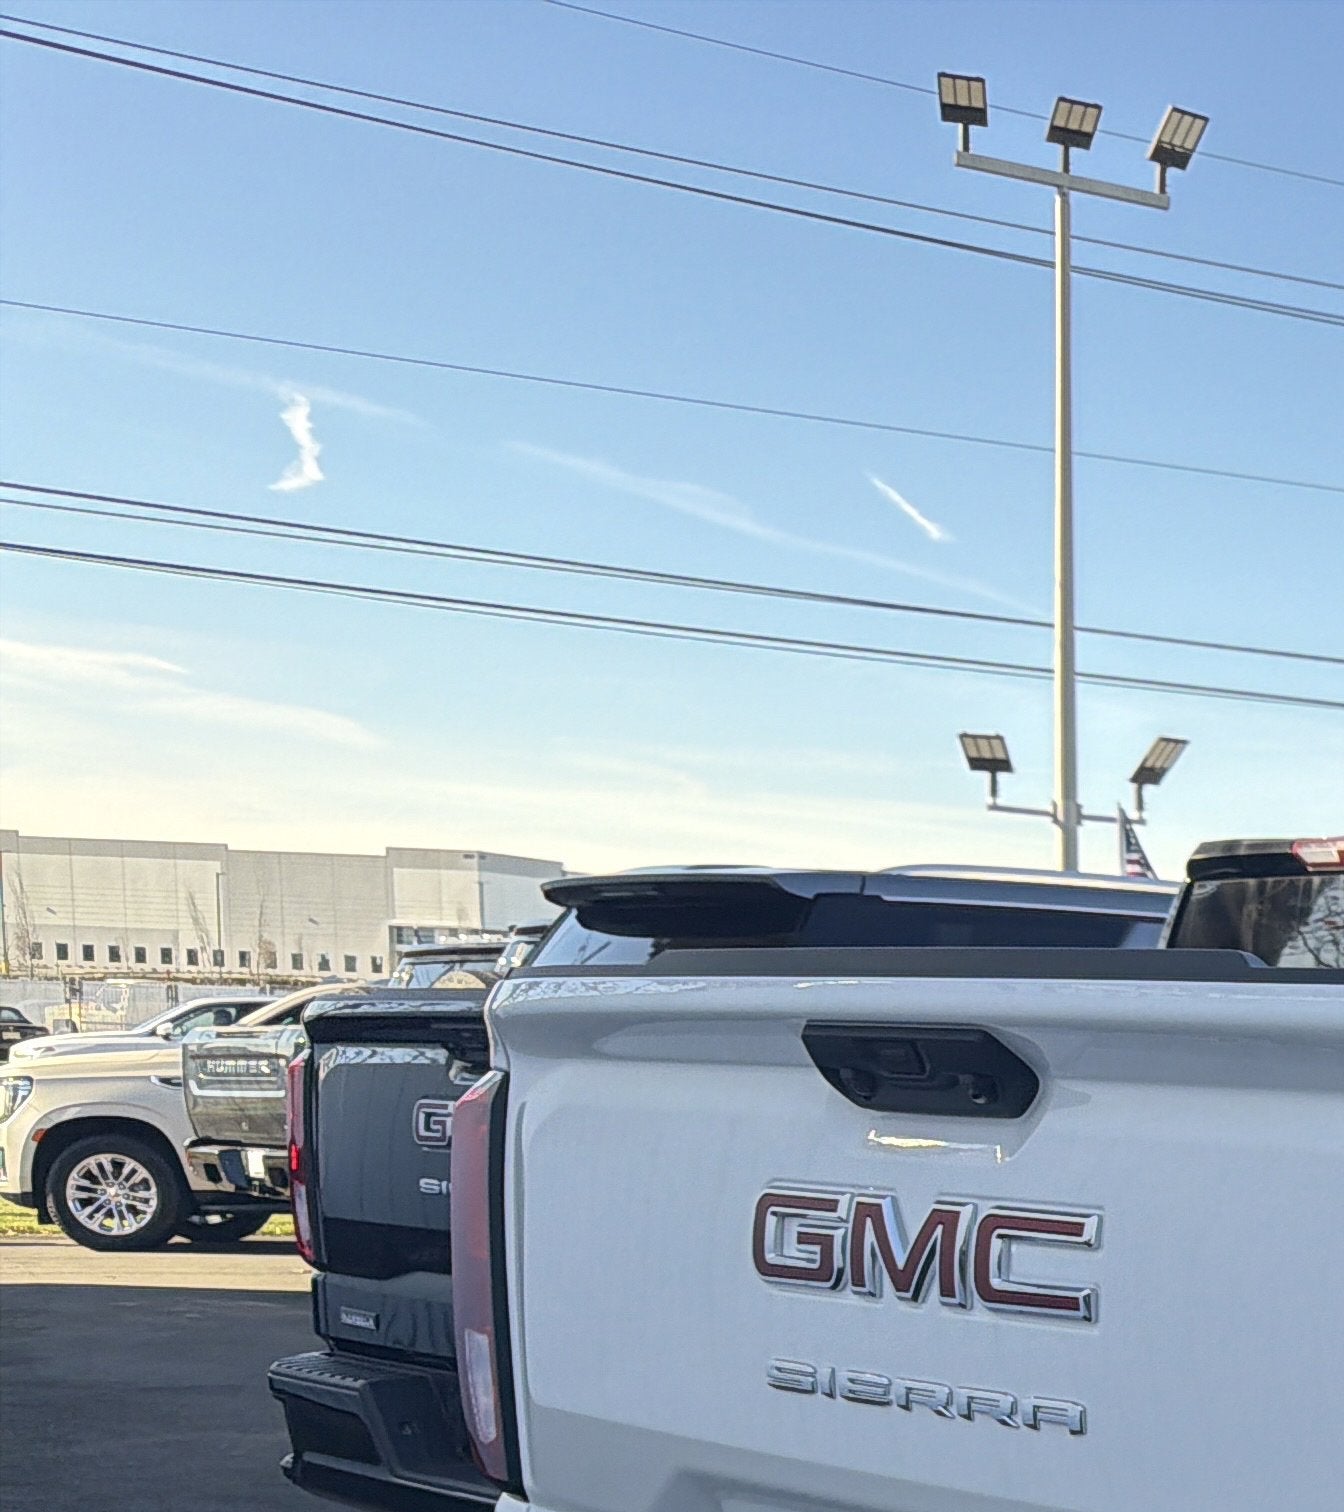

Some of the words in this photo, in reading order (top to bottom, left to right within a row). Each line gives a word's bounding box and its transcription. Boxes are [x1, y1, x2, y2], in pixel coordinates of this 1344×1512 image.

[206, 1059, 271, 1074] HUMMER
[752, 1181, 1103, 1324] GMC
[767, 1357, 1088, 1435] SIERRA
